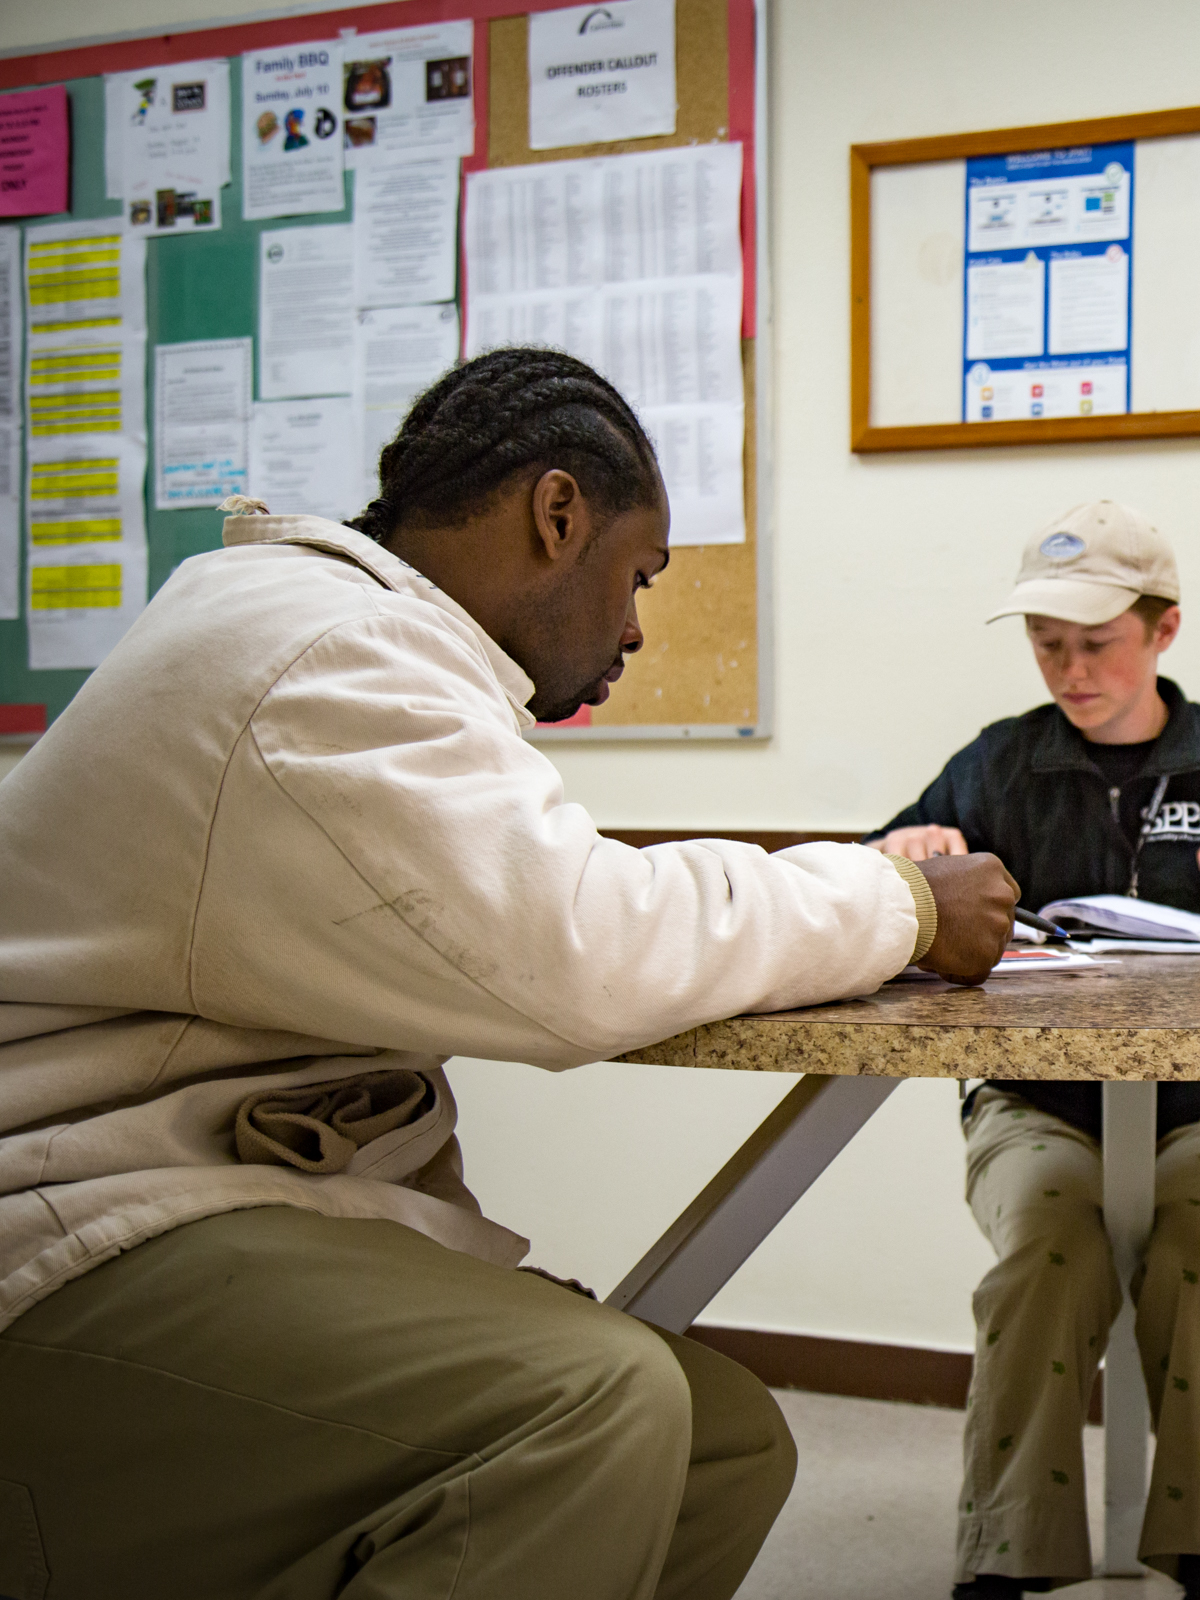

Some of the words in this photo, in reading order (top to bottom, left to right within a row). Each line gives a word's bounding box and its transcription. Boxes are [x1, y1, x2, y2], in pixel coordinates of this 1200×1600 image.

[255, 55, 295, 74] Family
[298, 50, 330, 69] BBQ
[546, 61, 605, 80] OFFENDER
[607, 52, 657, 72] CALLOUT
[295, 85, 313, 99] July
[577, 81, 628, 98] ROSTERS
